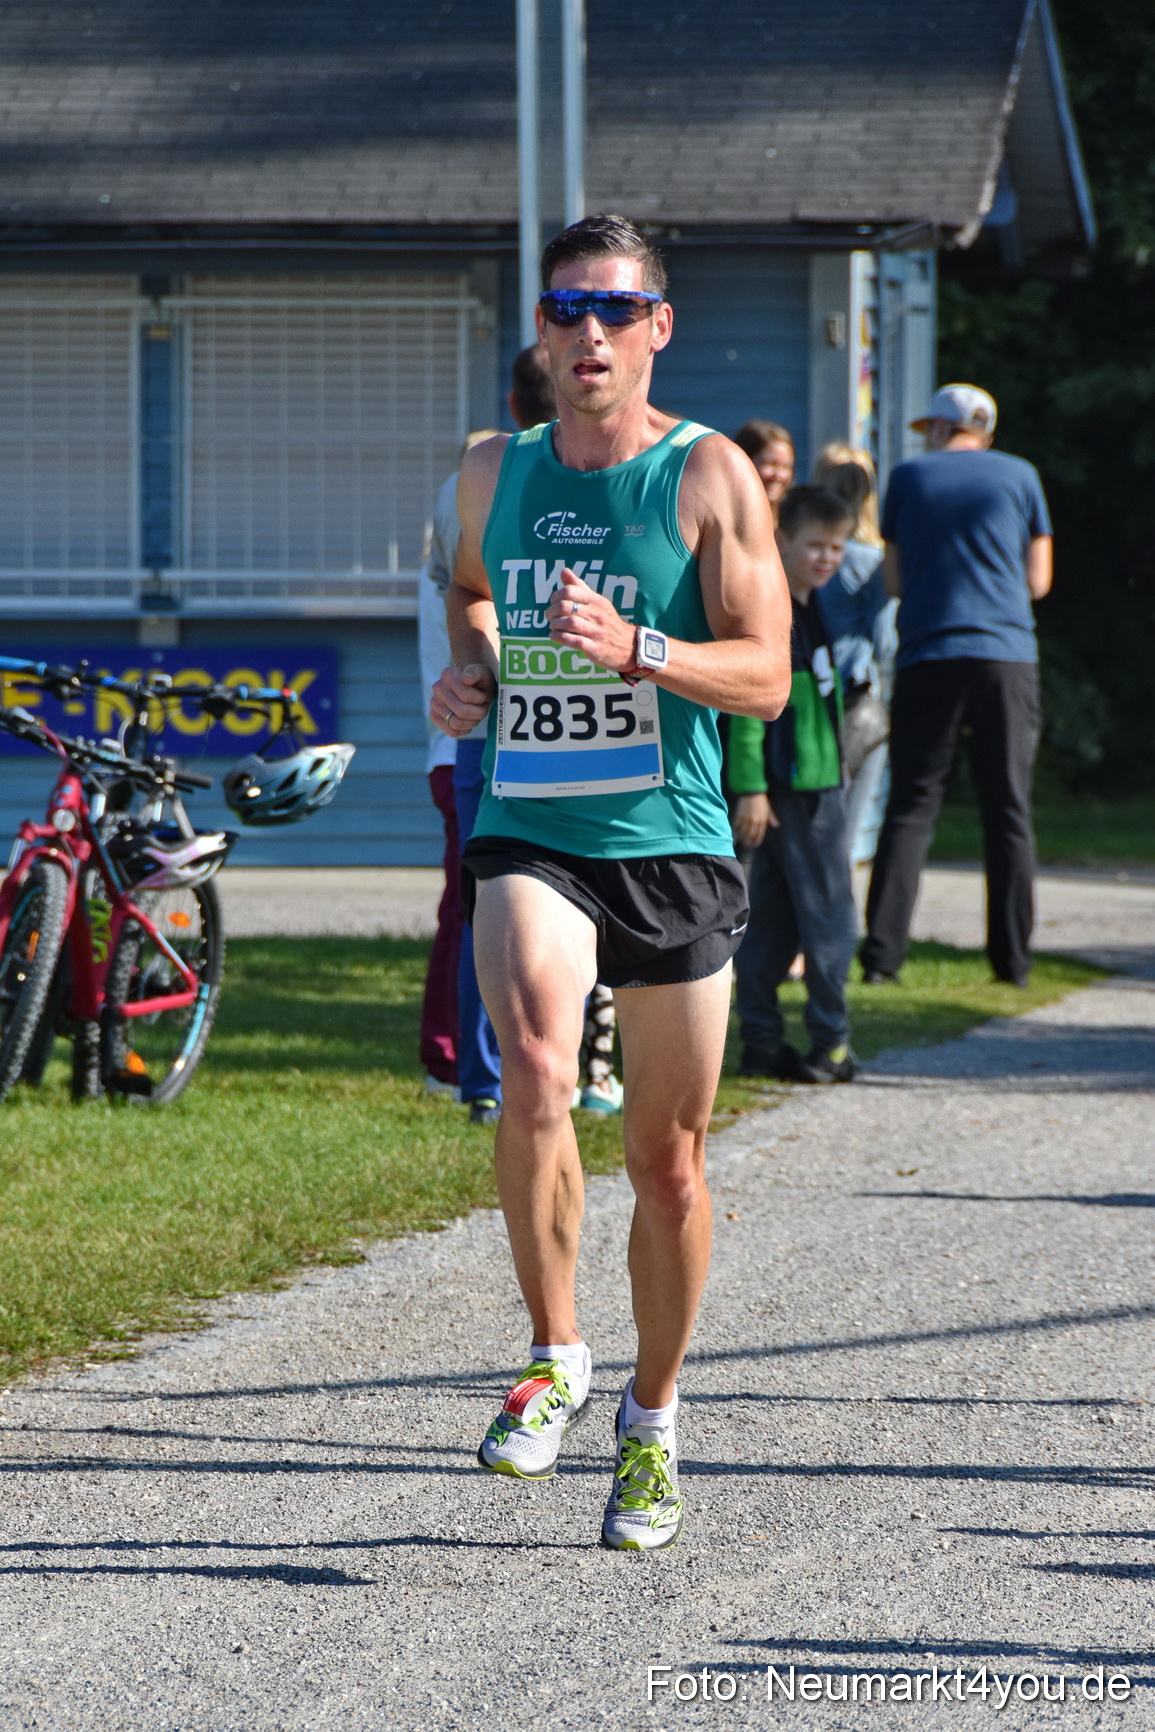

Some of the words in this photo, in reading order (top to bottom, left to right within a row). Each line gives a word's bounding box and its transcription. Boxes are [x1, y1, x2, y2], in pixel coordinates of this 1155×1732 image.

[547, 522, 611, 537] Fischer
[501, 559, 638, 609] TWin
[509, 693, 637, 742] 2835
